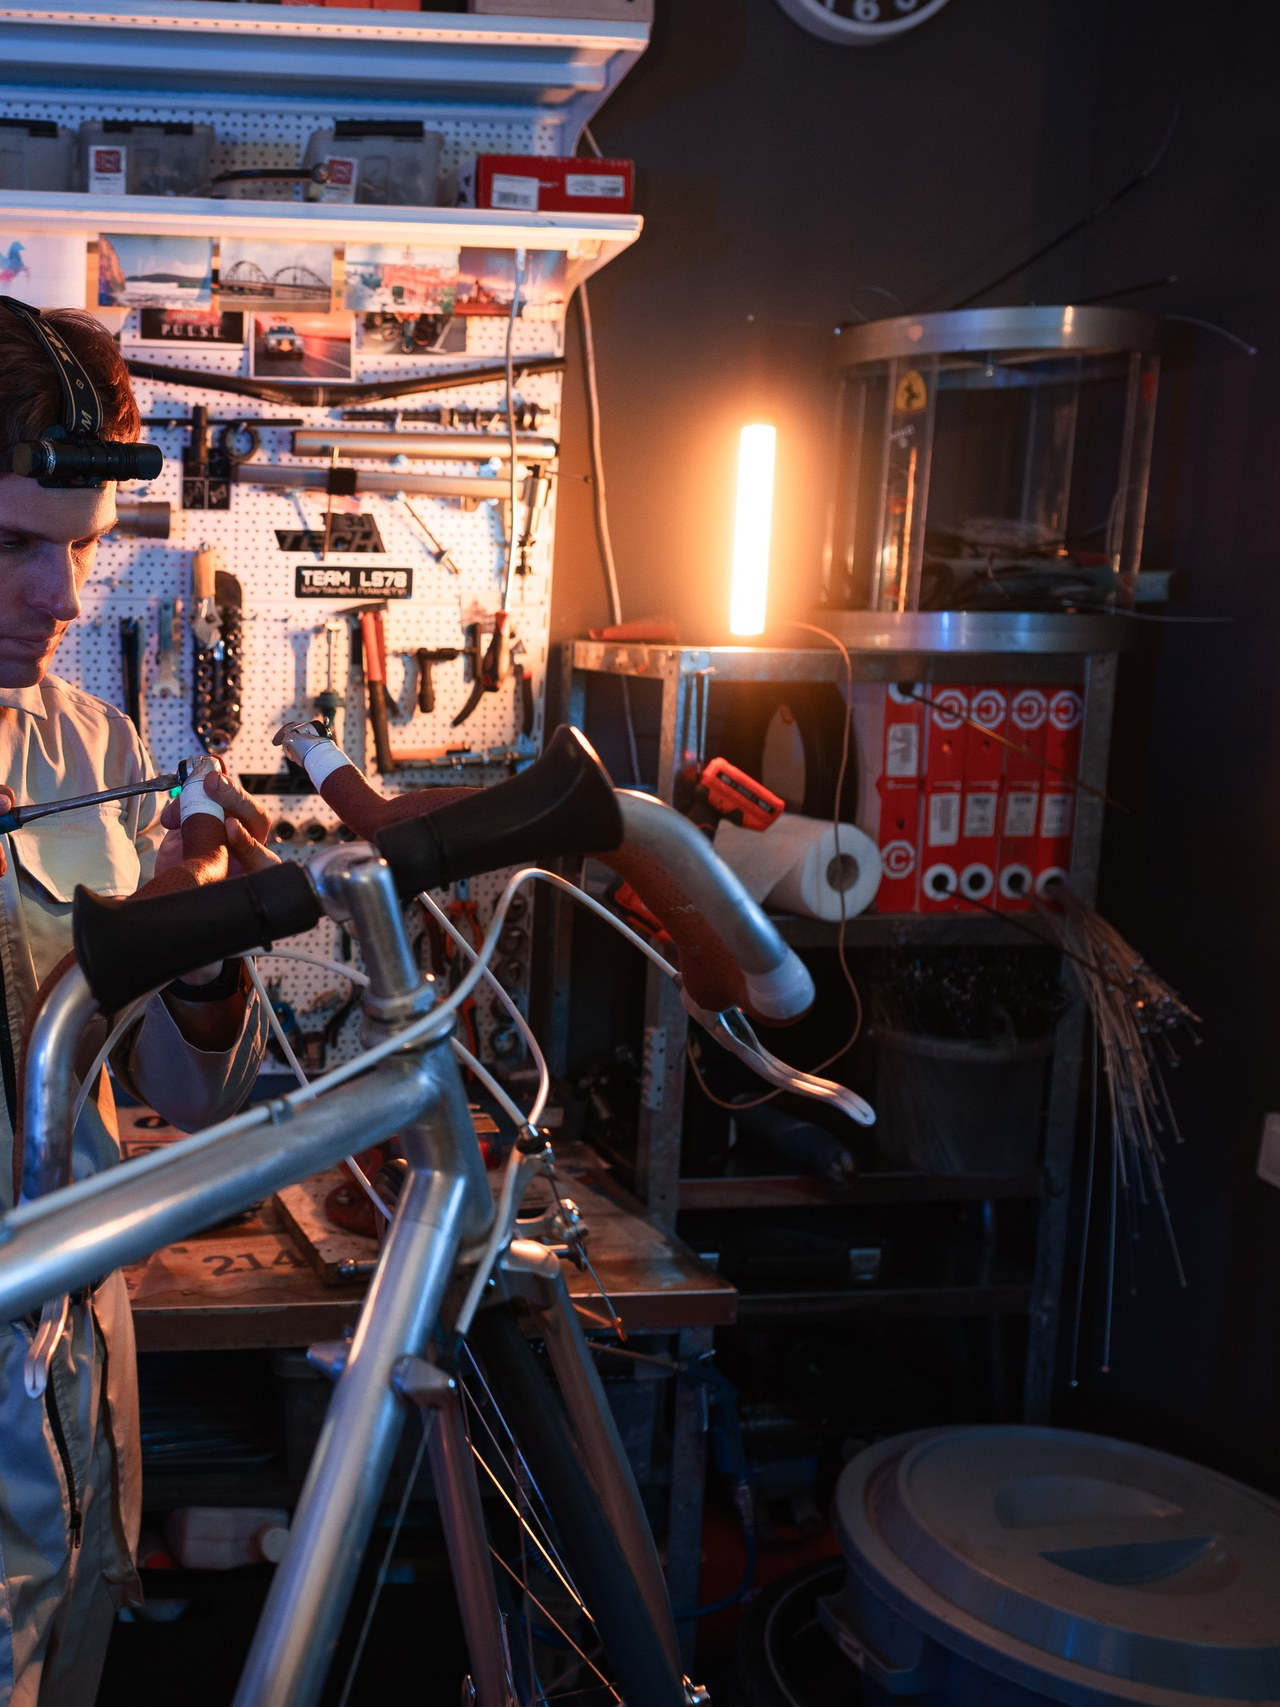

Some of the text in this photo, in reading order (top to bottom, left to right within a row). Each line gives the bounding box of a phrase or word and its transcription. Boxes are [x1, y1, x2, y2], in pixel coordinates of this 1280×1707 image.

[301, 570, 408, 587] TEAM LS78
[202, 1250, 312, 1276] 214
